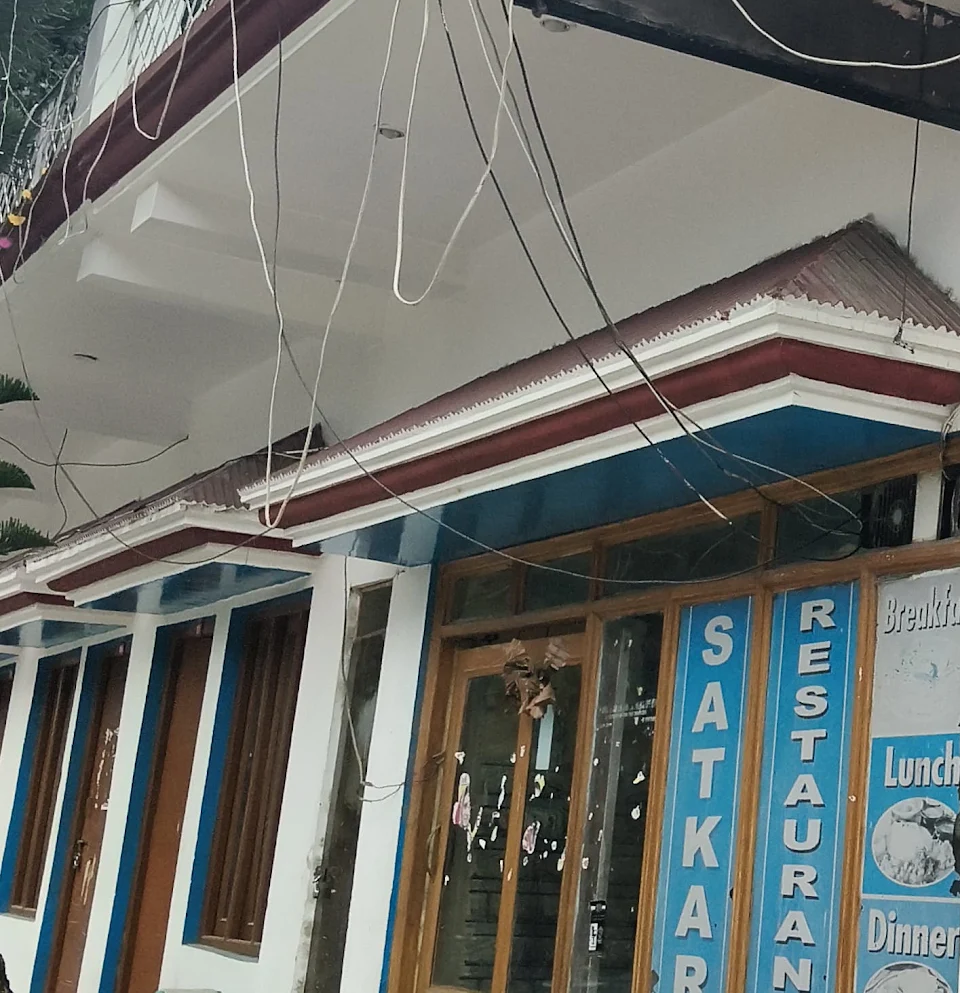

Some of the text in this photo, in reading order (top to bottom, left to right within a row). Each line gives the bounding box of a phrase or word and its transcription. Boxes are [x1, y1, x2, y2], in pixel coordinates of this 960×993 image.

[884, 740, 960, 787] Lunch
[673, 615, 734, 993] SATKAR
[867, 908, 960, 958] Dinner
